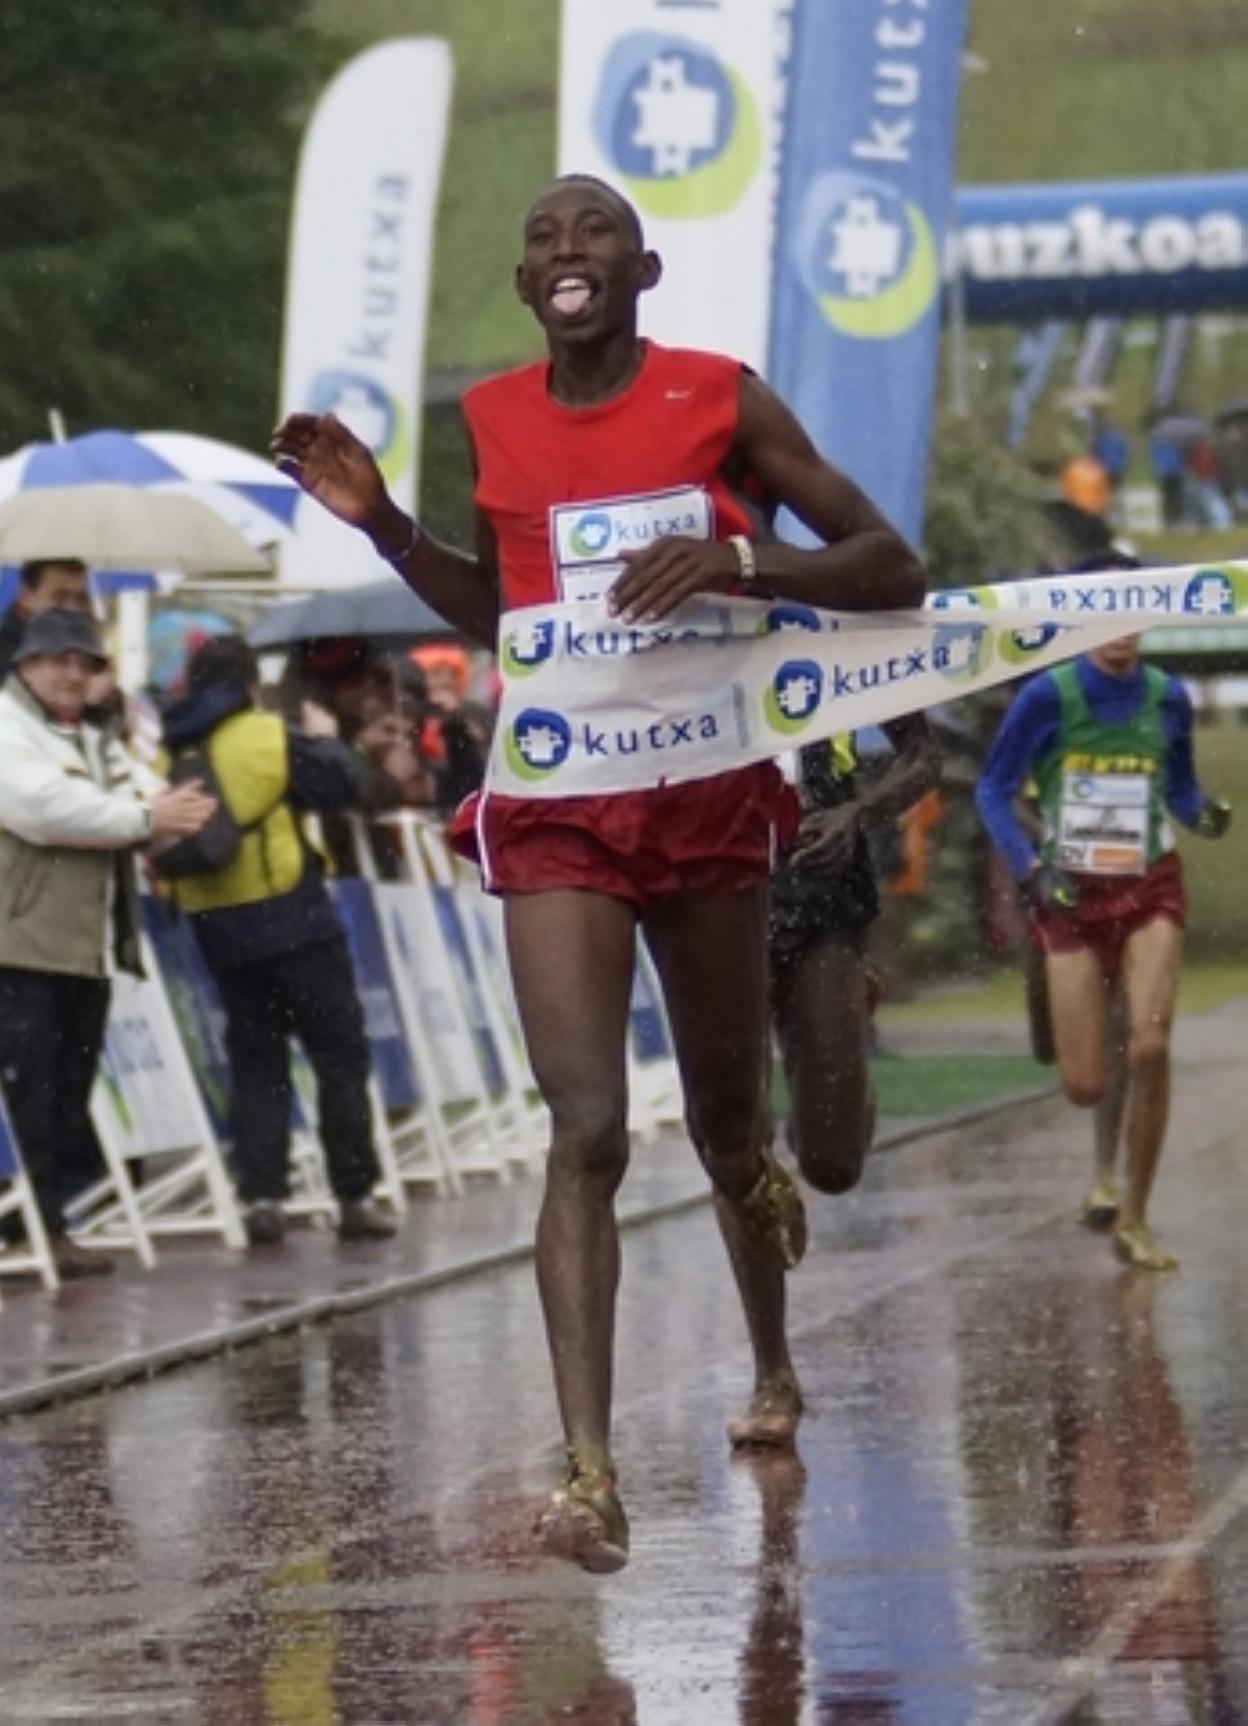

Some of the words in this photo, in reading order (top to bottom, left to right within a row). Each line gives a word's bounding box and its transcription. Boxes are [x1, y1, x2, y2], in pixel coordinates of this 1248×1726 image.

[850, 0, 930, 161] kut
[347, 174, 408, 360] kutxa
[614, 512, 698, 542] kutxa
[1050, 582, 1171, 612] kutxa
[834, 646, 950, 697] kutxa
[584, 713, 718, 756] kutxa
